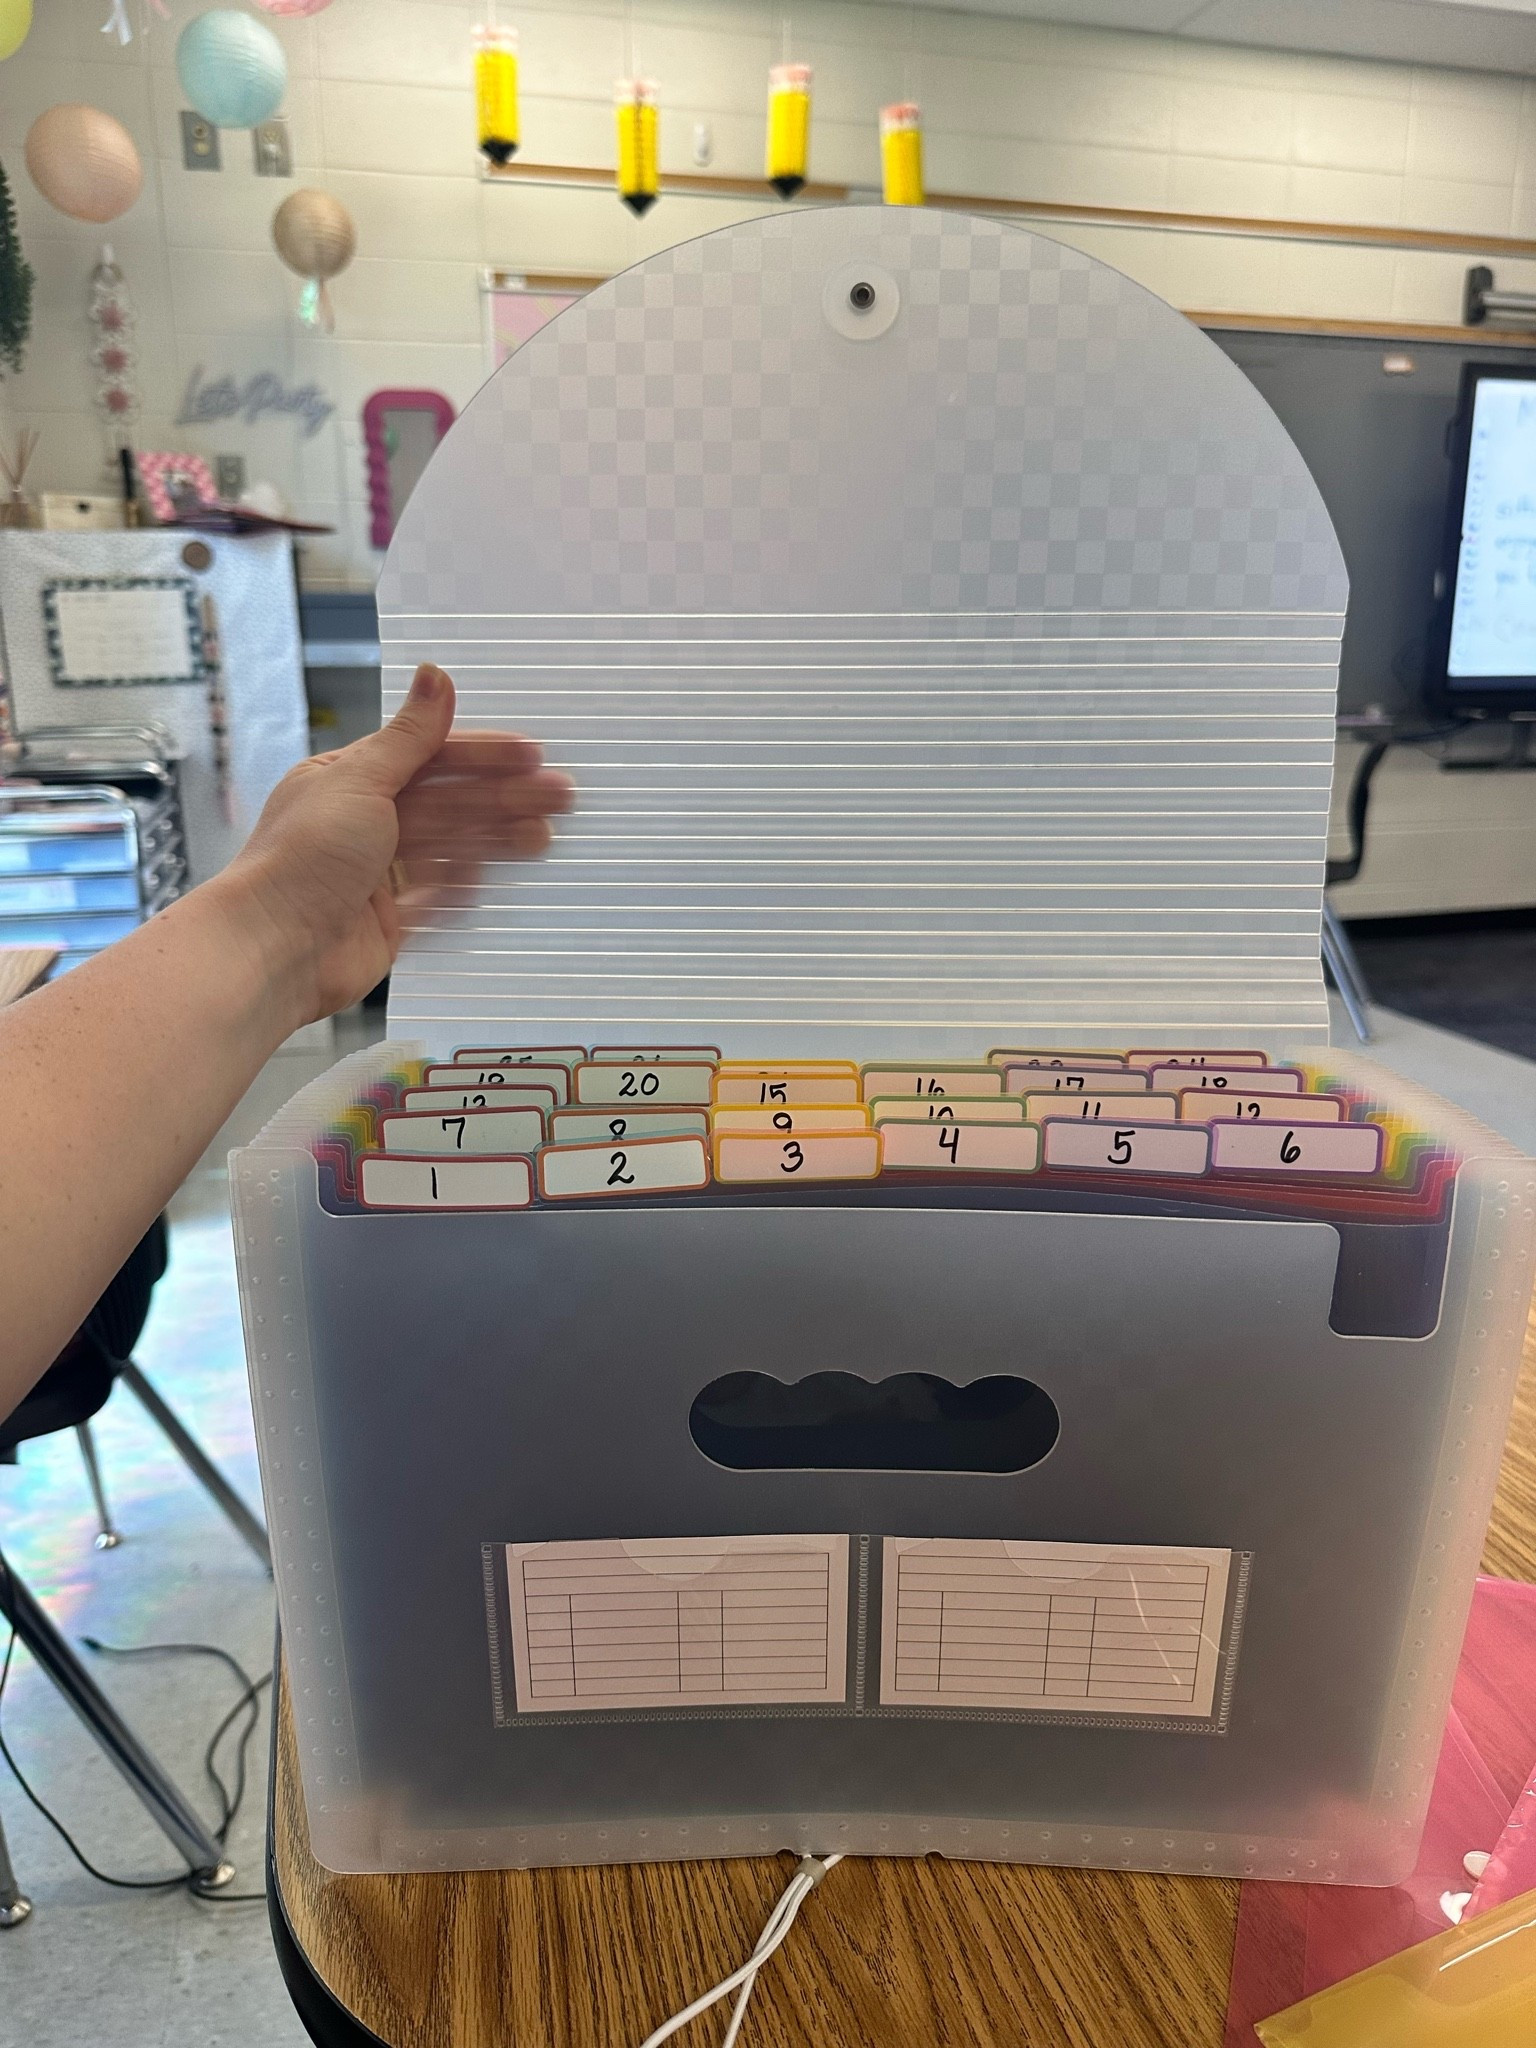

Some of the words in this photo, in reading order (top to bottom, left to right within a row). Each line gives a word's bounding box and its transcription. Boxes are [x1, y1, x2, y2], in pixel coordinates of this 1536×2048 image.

[618, 1071, 660, 1097] 20
[760, 1082, 787, 1105] 15
[917, 1077, 945, 1096] 16
[772, 1112, 793, 1134] 9
[1082, 1100, 1101, 1119] 11
[441, 1117, 466, 1150] 7
[938, 1127, 960, 1164] 4
[1107, 1130, 1136, 1165] 5
[1280, 1131, 1301, 1164] 6
[606, 1151, 635, 1186] 2
[780, 1141, 804, 1173] 3
[429, 1166, 438, 1200] 1
